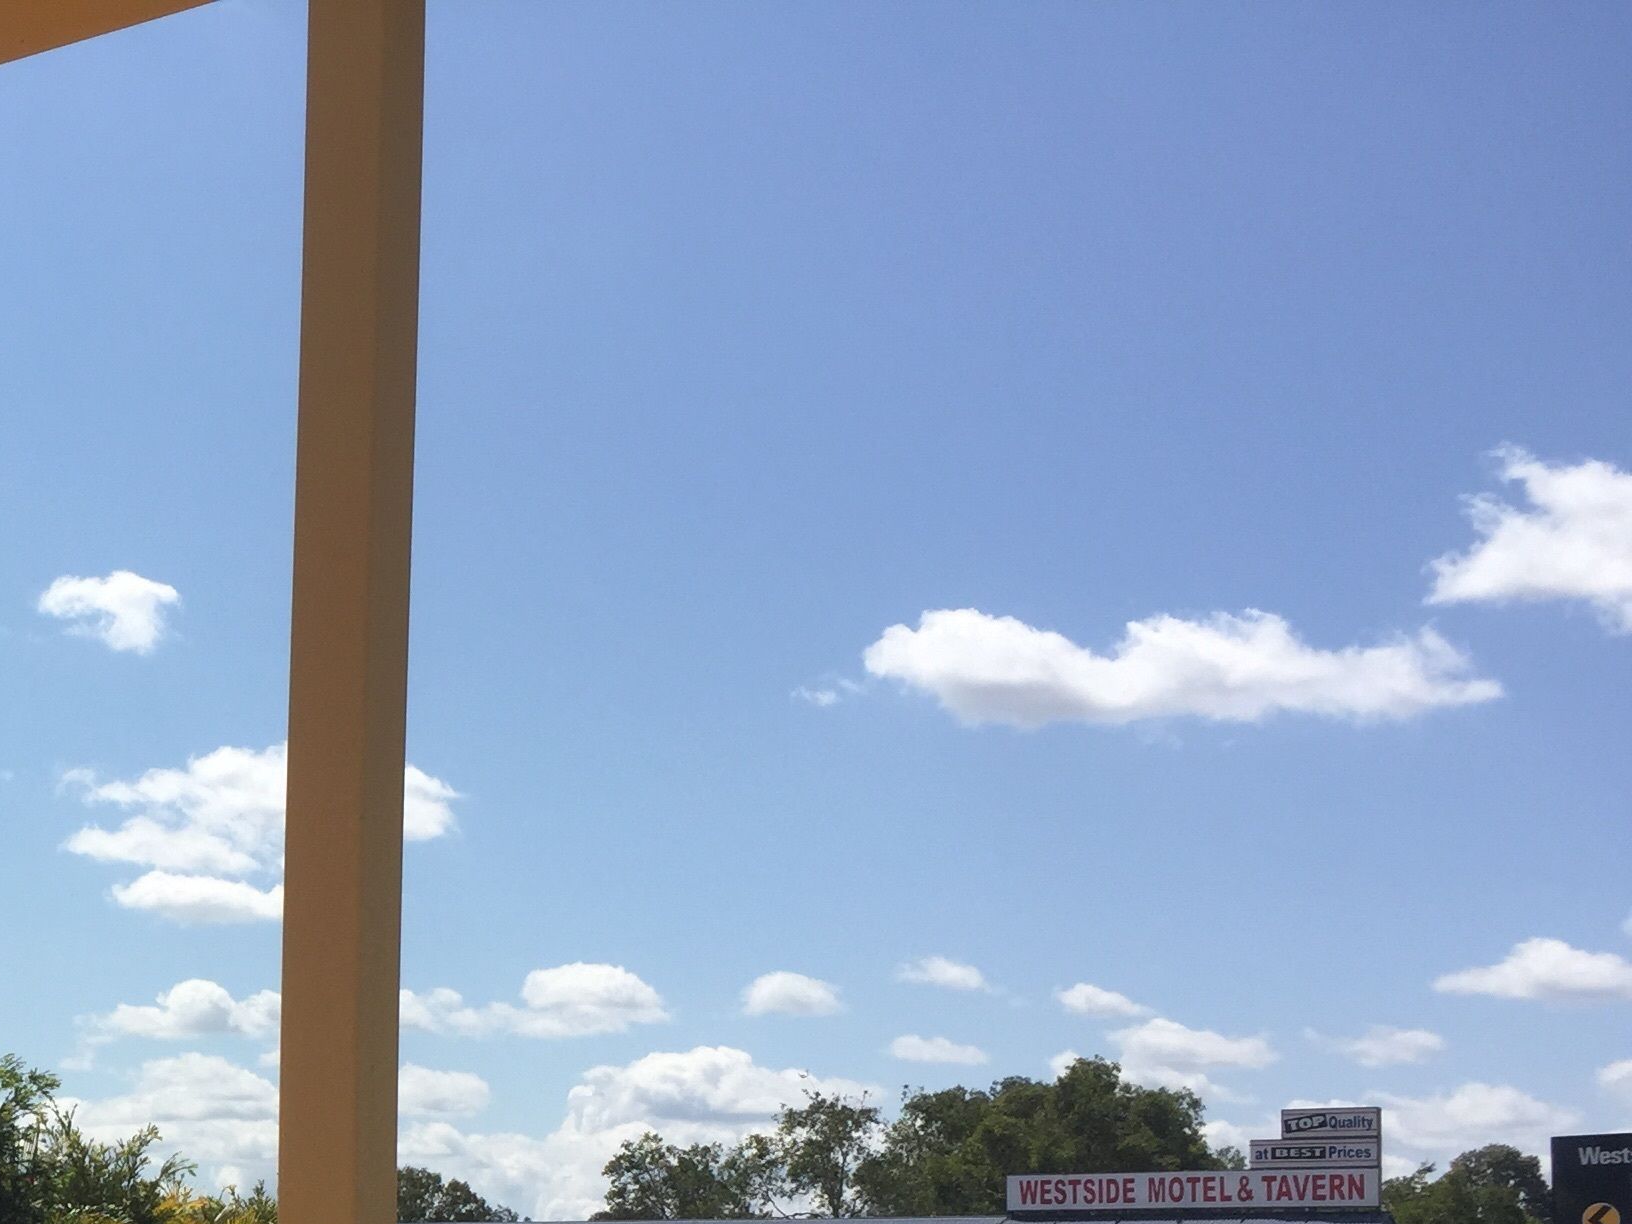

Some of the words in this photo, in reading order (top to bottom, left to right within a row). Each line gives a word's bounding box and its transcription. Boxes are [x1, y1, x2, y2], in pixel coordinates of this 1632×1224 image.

[1287, 1115, 1325, 1131] TOP
[1328, 1115, 1374, 1131] Quality
[1255, 1148, 1269, 1160] at
[1274, 1148, 1324, 1159] BEST
[1328, 1146, 1372, 1159] Prices
[1578, 1146, 1632, 1165] West
[1019, 1177, 1136, 1205] WESTSIDE
[1148, 1176, 1233, 1203] MOTEL
[1237, 1175, 1254, 1202] &
[1261, 1173, 1365, 1202] TAVERN
